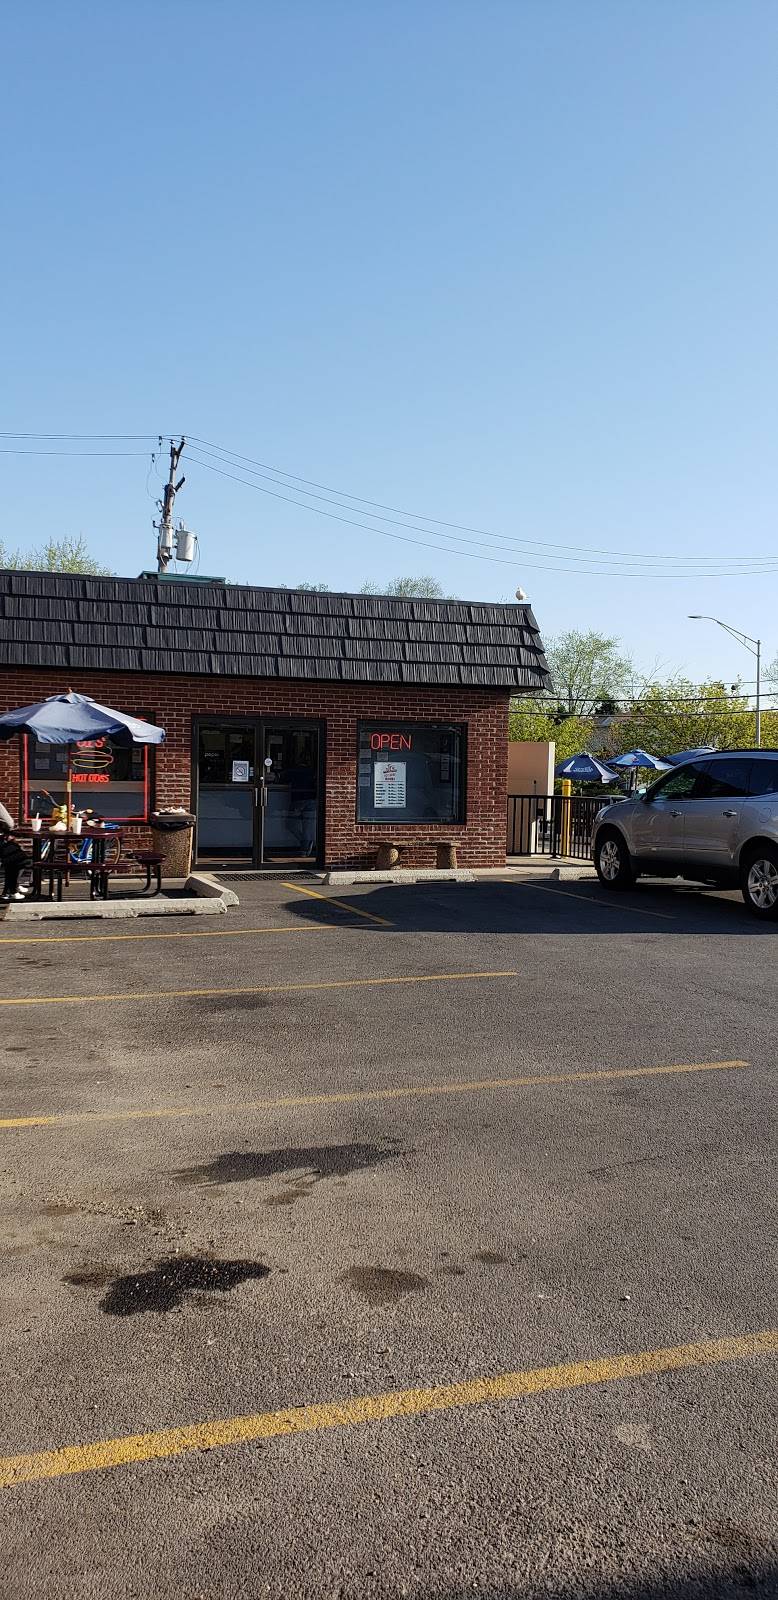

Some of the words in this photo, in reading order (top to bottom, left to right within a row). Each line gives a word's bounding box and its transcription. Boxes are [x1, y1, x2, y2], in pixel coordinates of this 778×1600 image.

[370, 733, 412, 751] OPEN
[72, 773, 88, 783] HOT
[88, 773, 110, 783] DOGS
